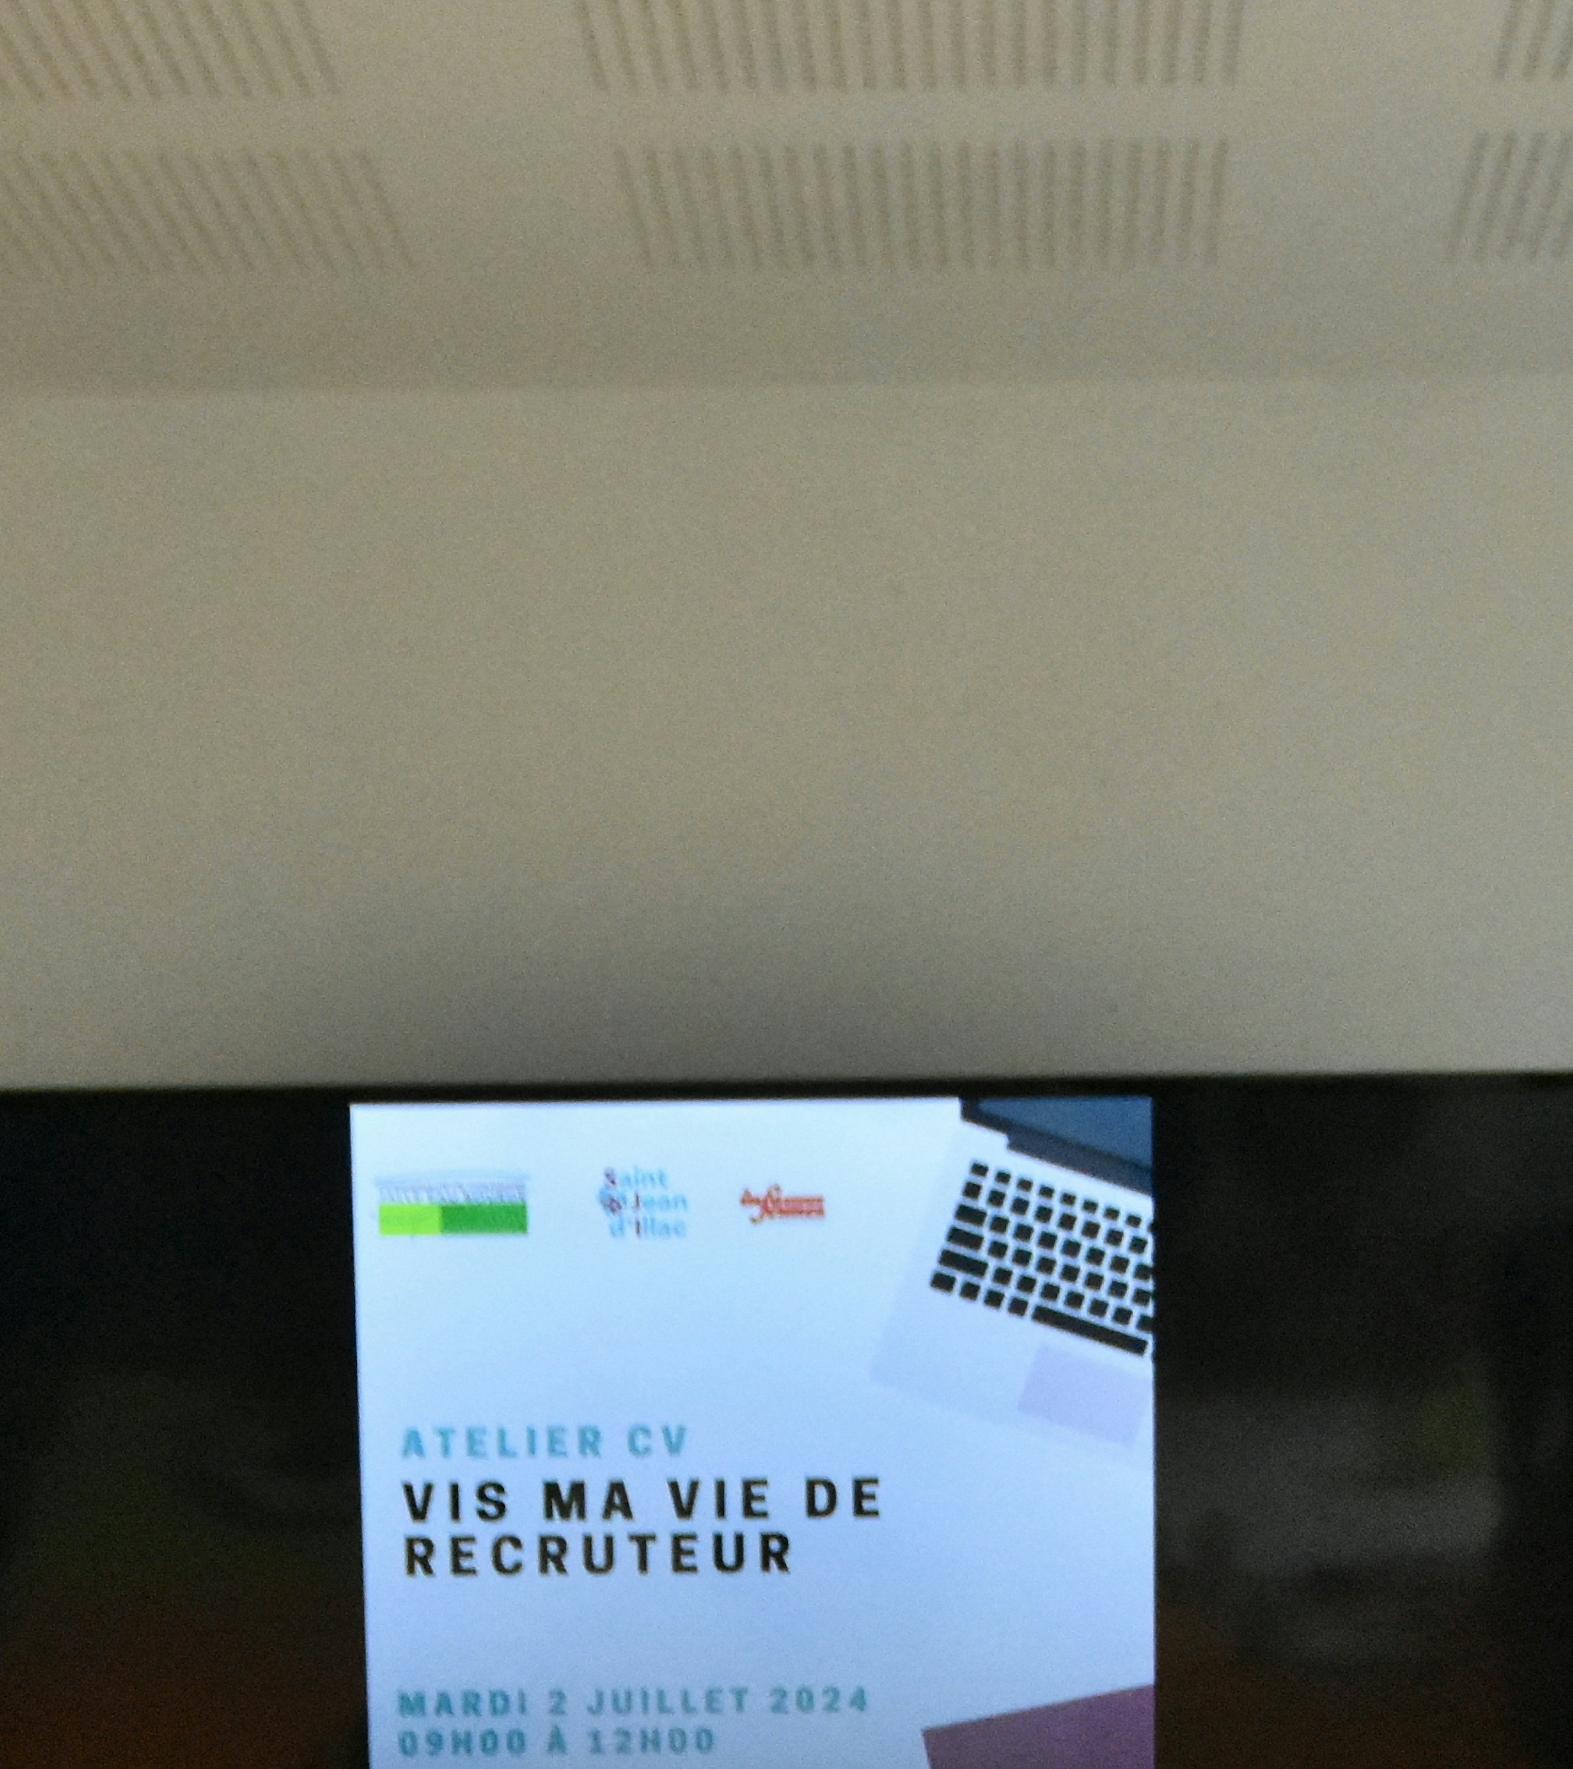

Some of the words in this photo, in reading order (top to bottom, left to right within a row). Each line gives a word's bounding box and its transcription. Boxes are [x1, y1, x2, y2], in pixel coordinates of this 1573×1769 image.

[402, 1425, 602, 1458] ATELIER
[629, 1424, 688, 1457] CV
[402, 1480, 507, 1522] VIS
[543, 1479, 635, 1521] MA
[667, 1477, 769, 1519] VIE
[806, 1477, 880, 1518] DE
[404, 1532, 790, 1576] RECRUTEUR
[399, 1688, 528, 1718] MARDI
[547, 1688, 568, 1716] 2
[586, 1687, 749, 1716] JUILLET
[769, 1685, 868, 1714] 2024
[399, 1728, 527, 1757] 09H00
[587, 1727, 715, 1754] 12H00
